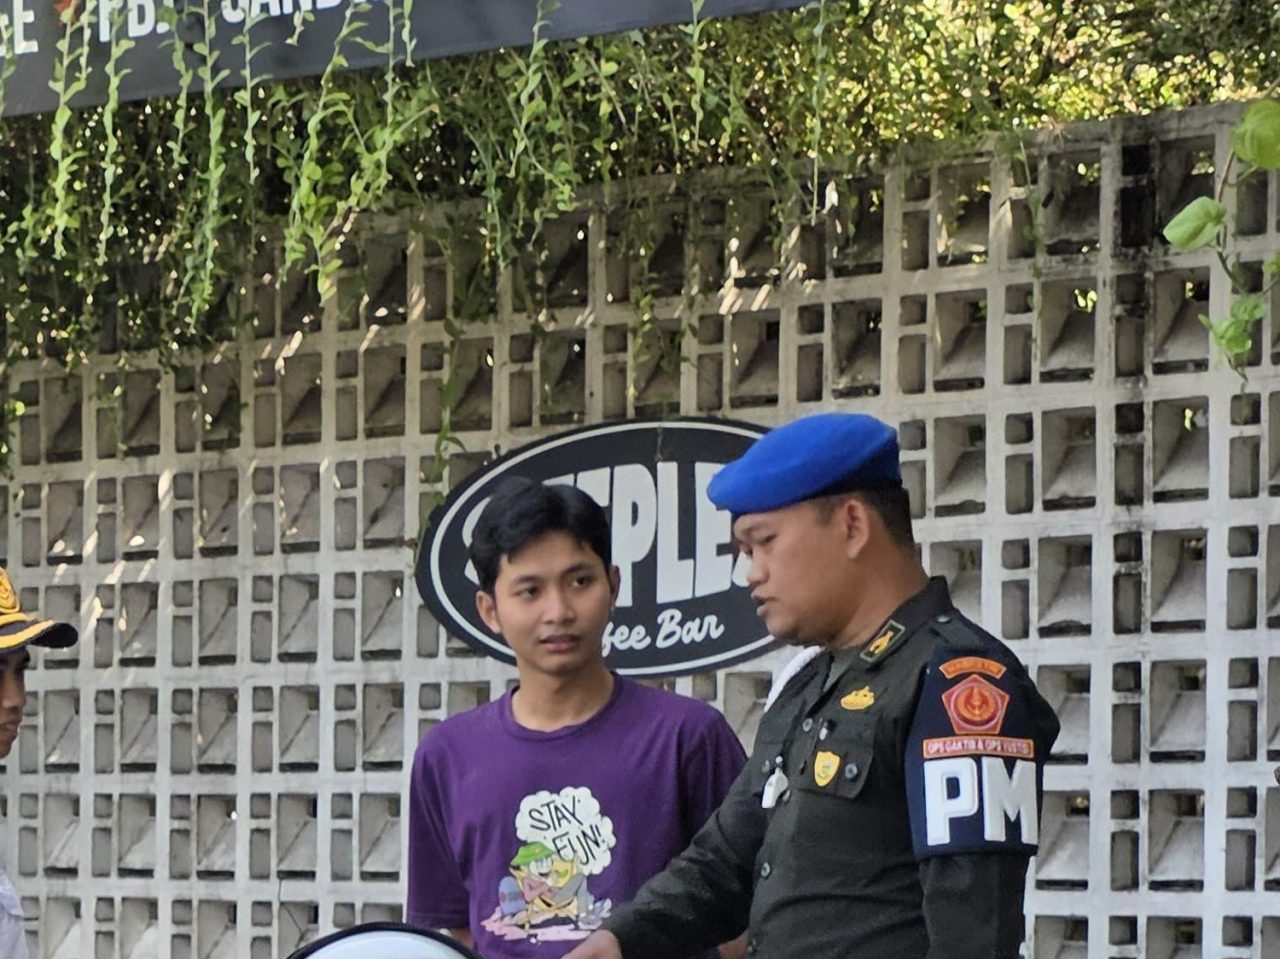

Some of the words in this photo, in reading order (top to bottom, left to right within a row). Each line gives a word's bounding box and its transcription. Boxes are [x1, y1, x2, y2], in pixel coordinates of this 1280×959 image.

[656, 608, 725, 650] Bar
[528, 795, 584, 832] STAY
[923, 756, 1039, 847] PM
